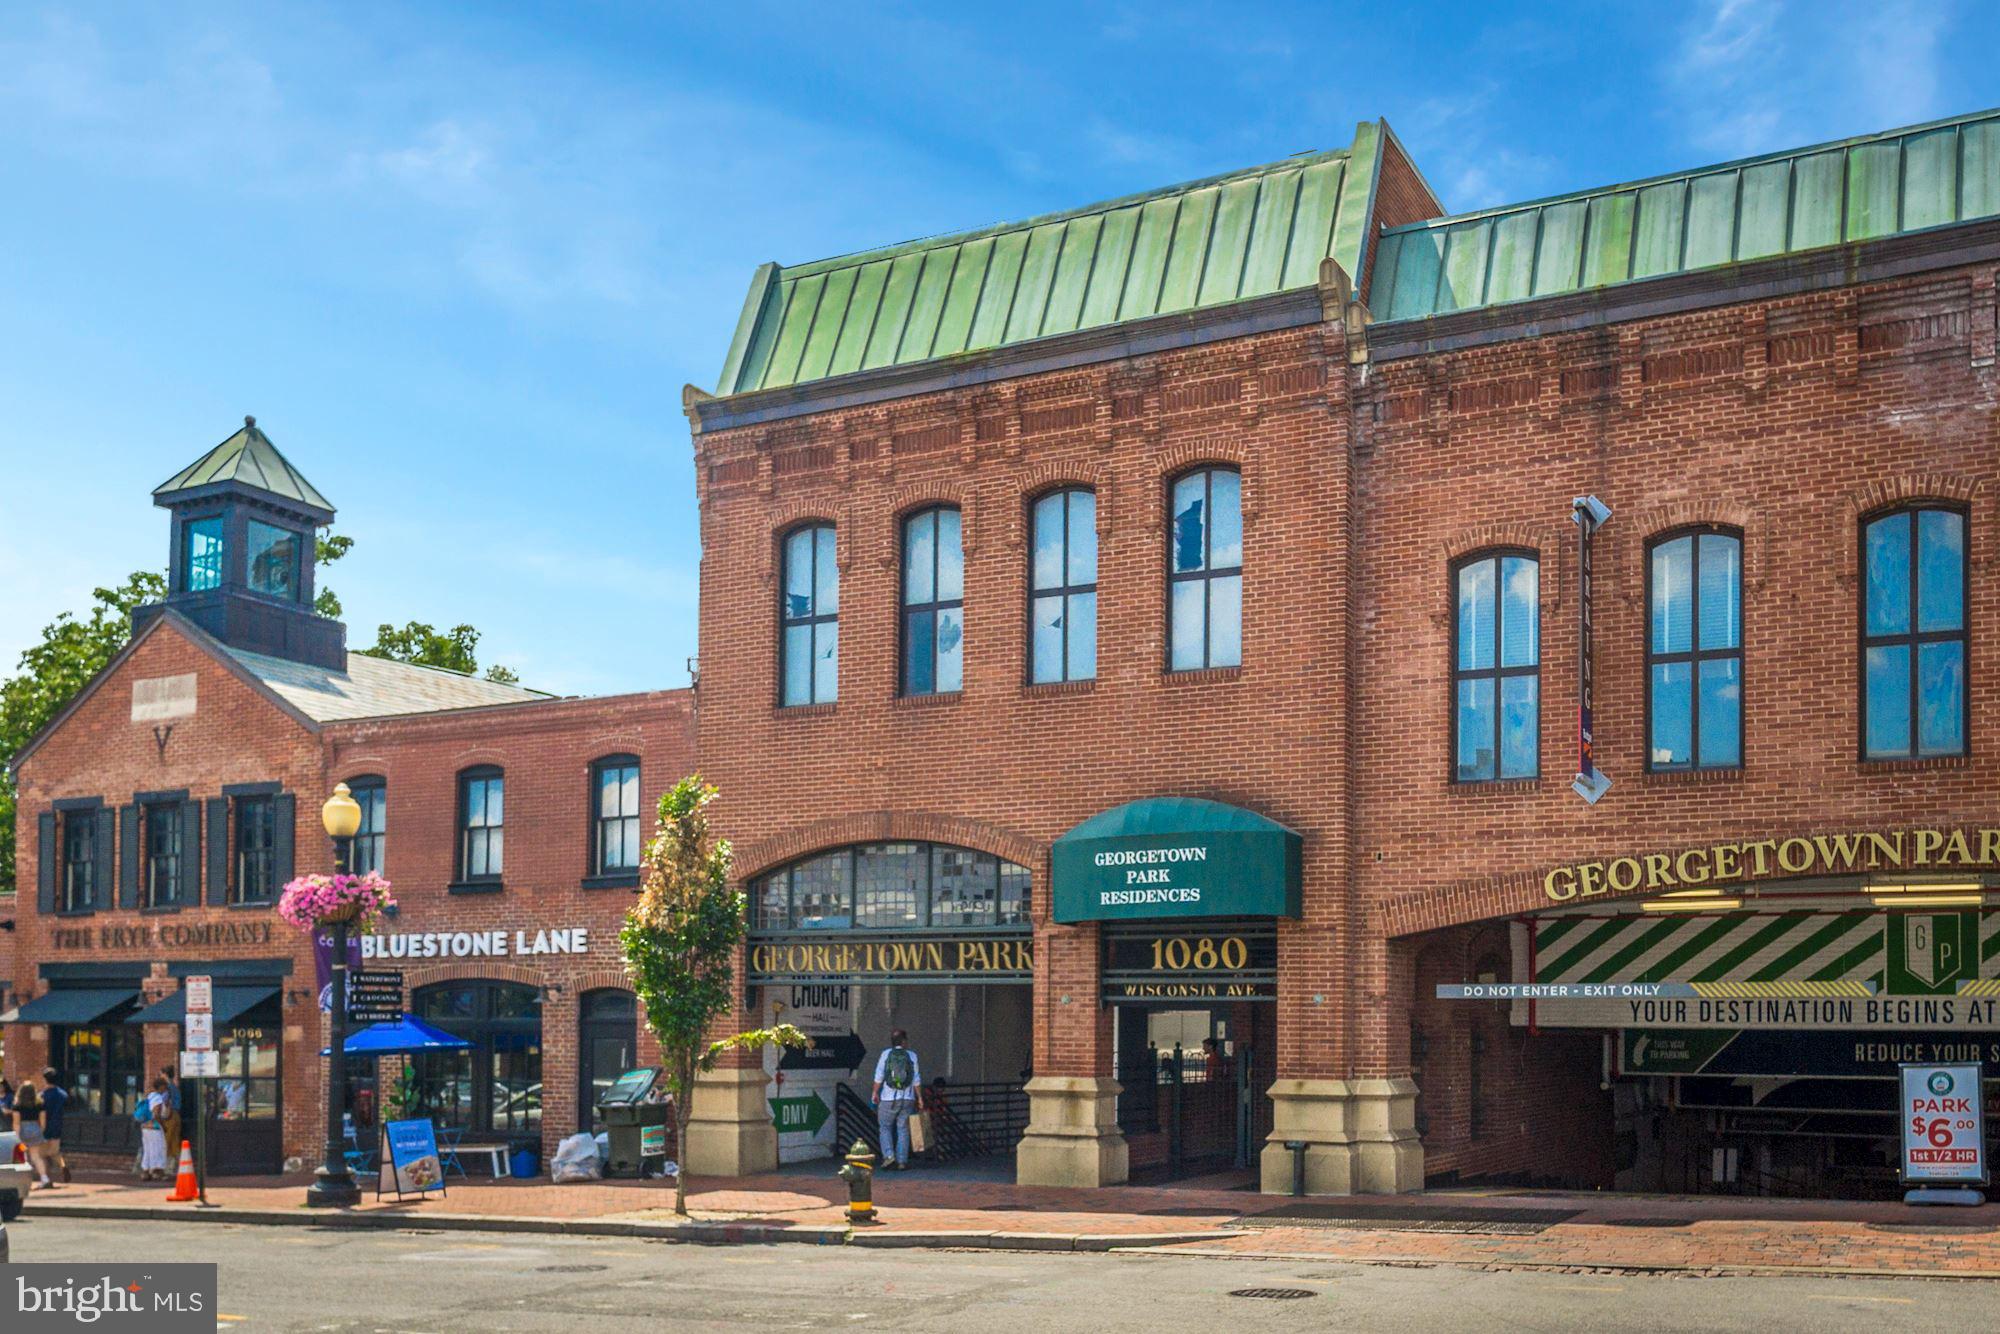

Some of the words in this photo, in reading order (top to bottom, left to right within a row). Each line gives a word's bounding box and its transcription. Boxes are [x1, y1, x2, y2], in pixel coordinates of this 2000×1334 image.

[1584, 518, 1592, 710] PARKING
[1094, 847, 1207, 867] GEORGETOWN
[1544, 831, 1904, 901] GEORGETOWN
[1126, 869, 1171, 884] PARK
[1100, 888, 1201, 905] RESIDENCES
[51, 927, 93, 950] THE
[99, 924, 153, 949] FRYE
[159, 921, 272, 949] COMPANY
[361, 932, 508, 959] BLUESTONE
[516, 928, 588, 955] LANE
[753, 942, 943, 973] GEORGETOWN
[957, 942, 1034, 971] PARK
[1151, 937, 1247, 970] 1080
[792, 974, 849, 1010] CHURCH
[1124, 984, 1216, 996] WISCONSIN
[1463, 987, 1483, 996] DO
[1489, 986, 1516, 996] NOT
[1522, 986, 1567, 996] ENTER
[1584, 985, 1615, 996] EXIT
[1621, 985, 1661, 996] ONLY
[1629, 1000, 1686, 1023] YOUR
[1699, 1000, 1852, 1023] DESTINATION
[1867, 1000, 1954, 1024] BEGINS
[1967, 1000, 1996, 1024] AT
[1855, 1043, 1924, 1062] REDUCE
[1932, 1043, 1980, 1062] YOUR
[782, 1104, 809, 1125] DMV
[1912, 1098, 1971, 1113] PARK
[1911, 1151, 1929, 1161] 1st
[1932, 1150, 1953, 1162] 1/2
[1956, 1151, 1975, 1161] HR
